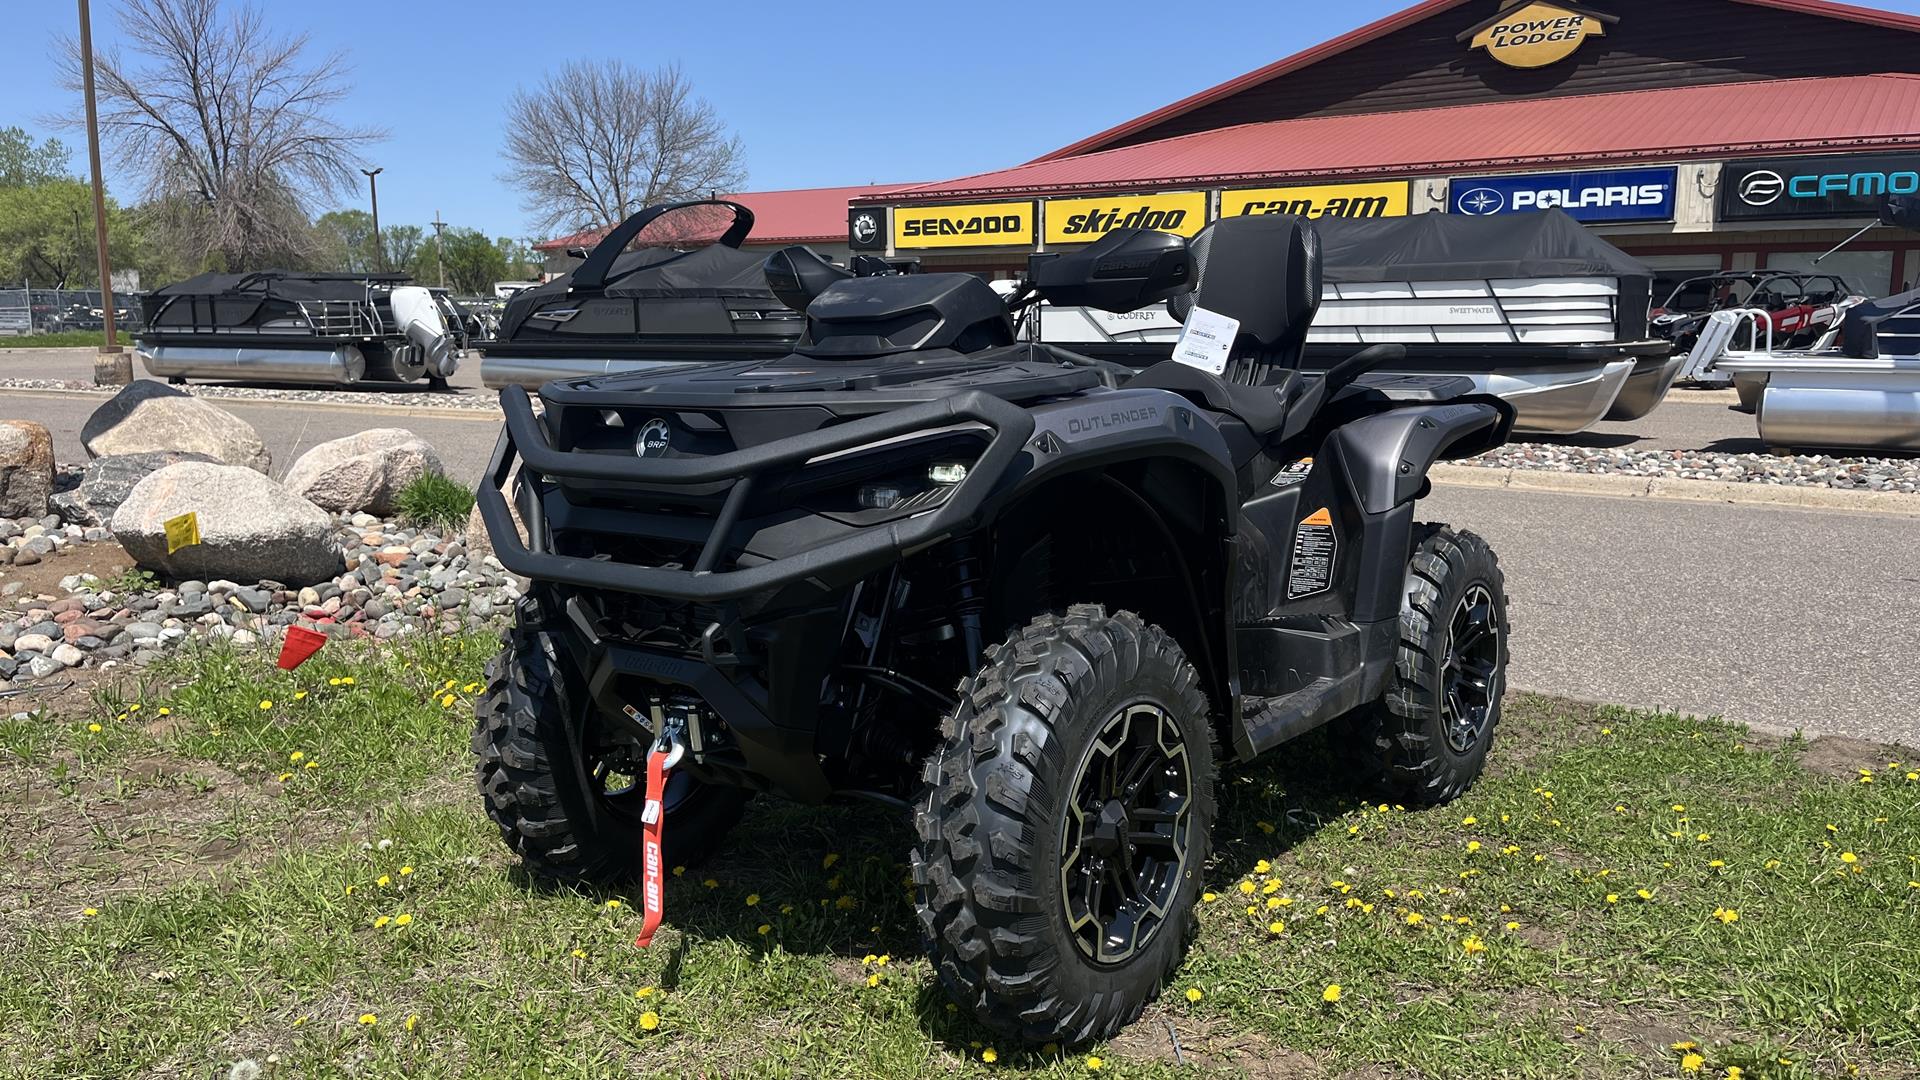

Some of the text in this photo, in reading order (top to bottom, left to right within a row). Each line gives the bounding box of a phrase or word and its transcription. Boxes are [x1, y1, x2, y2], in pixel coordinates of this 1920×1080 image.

[1490, 15, 1585, 38] POWER
[1494, 28, 1580, 48] LODGE
[1512, 184, 1664, 211] POLARIS
[1788, 171, 1919, 198] CFMO
[1062, 206, 1187, 234] ski-doo
[1117, 311, 1156, 321] GODFREY
[1068, 407, 1158, 434] OUTLANDER
[647, 440, 667, 449] BRP
[646, 841, 659, 913] can-am
